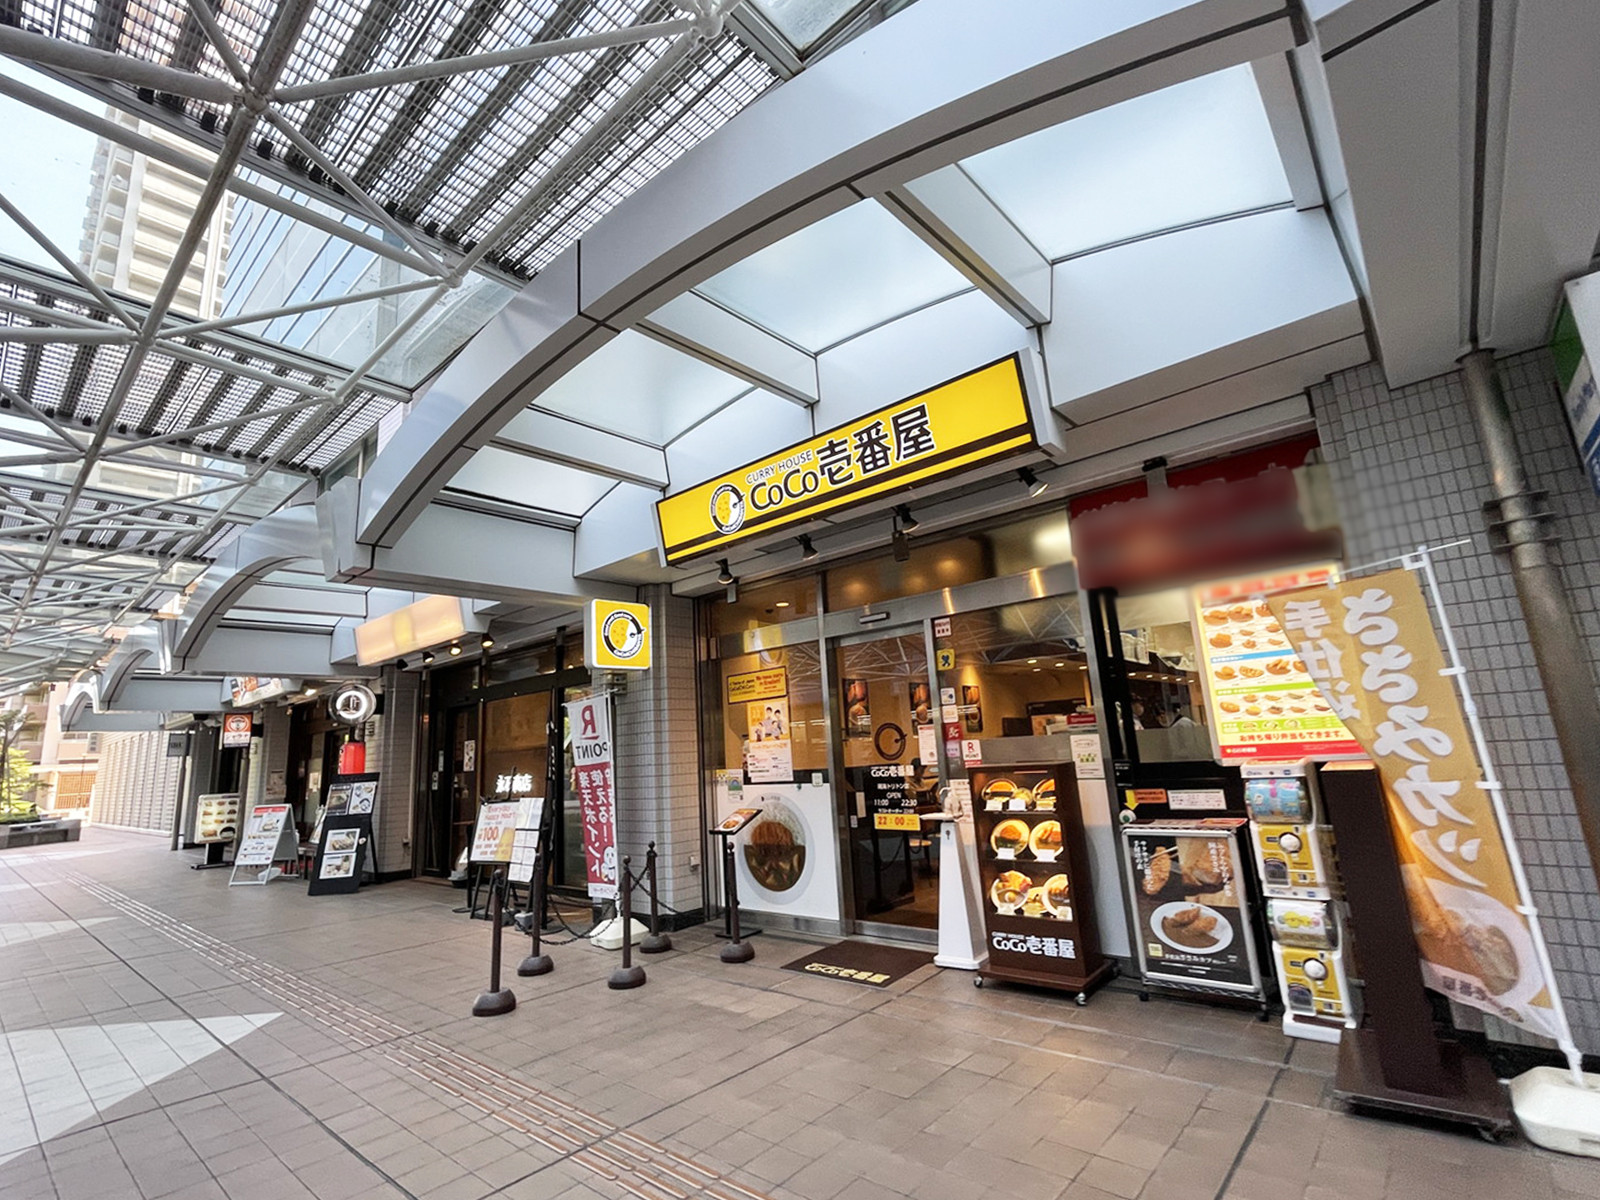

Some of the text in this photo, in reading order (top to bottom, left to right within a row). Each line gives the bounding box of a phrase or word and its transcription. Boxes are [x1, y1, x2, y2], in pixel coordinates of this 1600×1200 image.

[746, 450, 812, 484] CURRY HOUSE
[750, 404, 935, 510] CoCo壱番屋
[993, 936, 1076, 959] CoCo壱番屋
